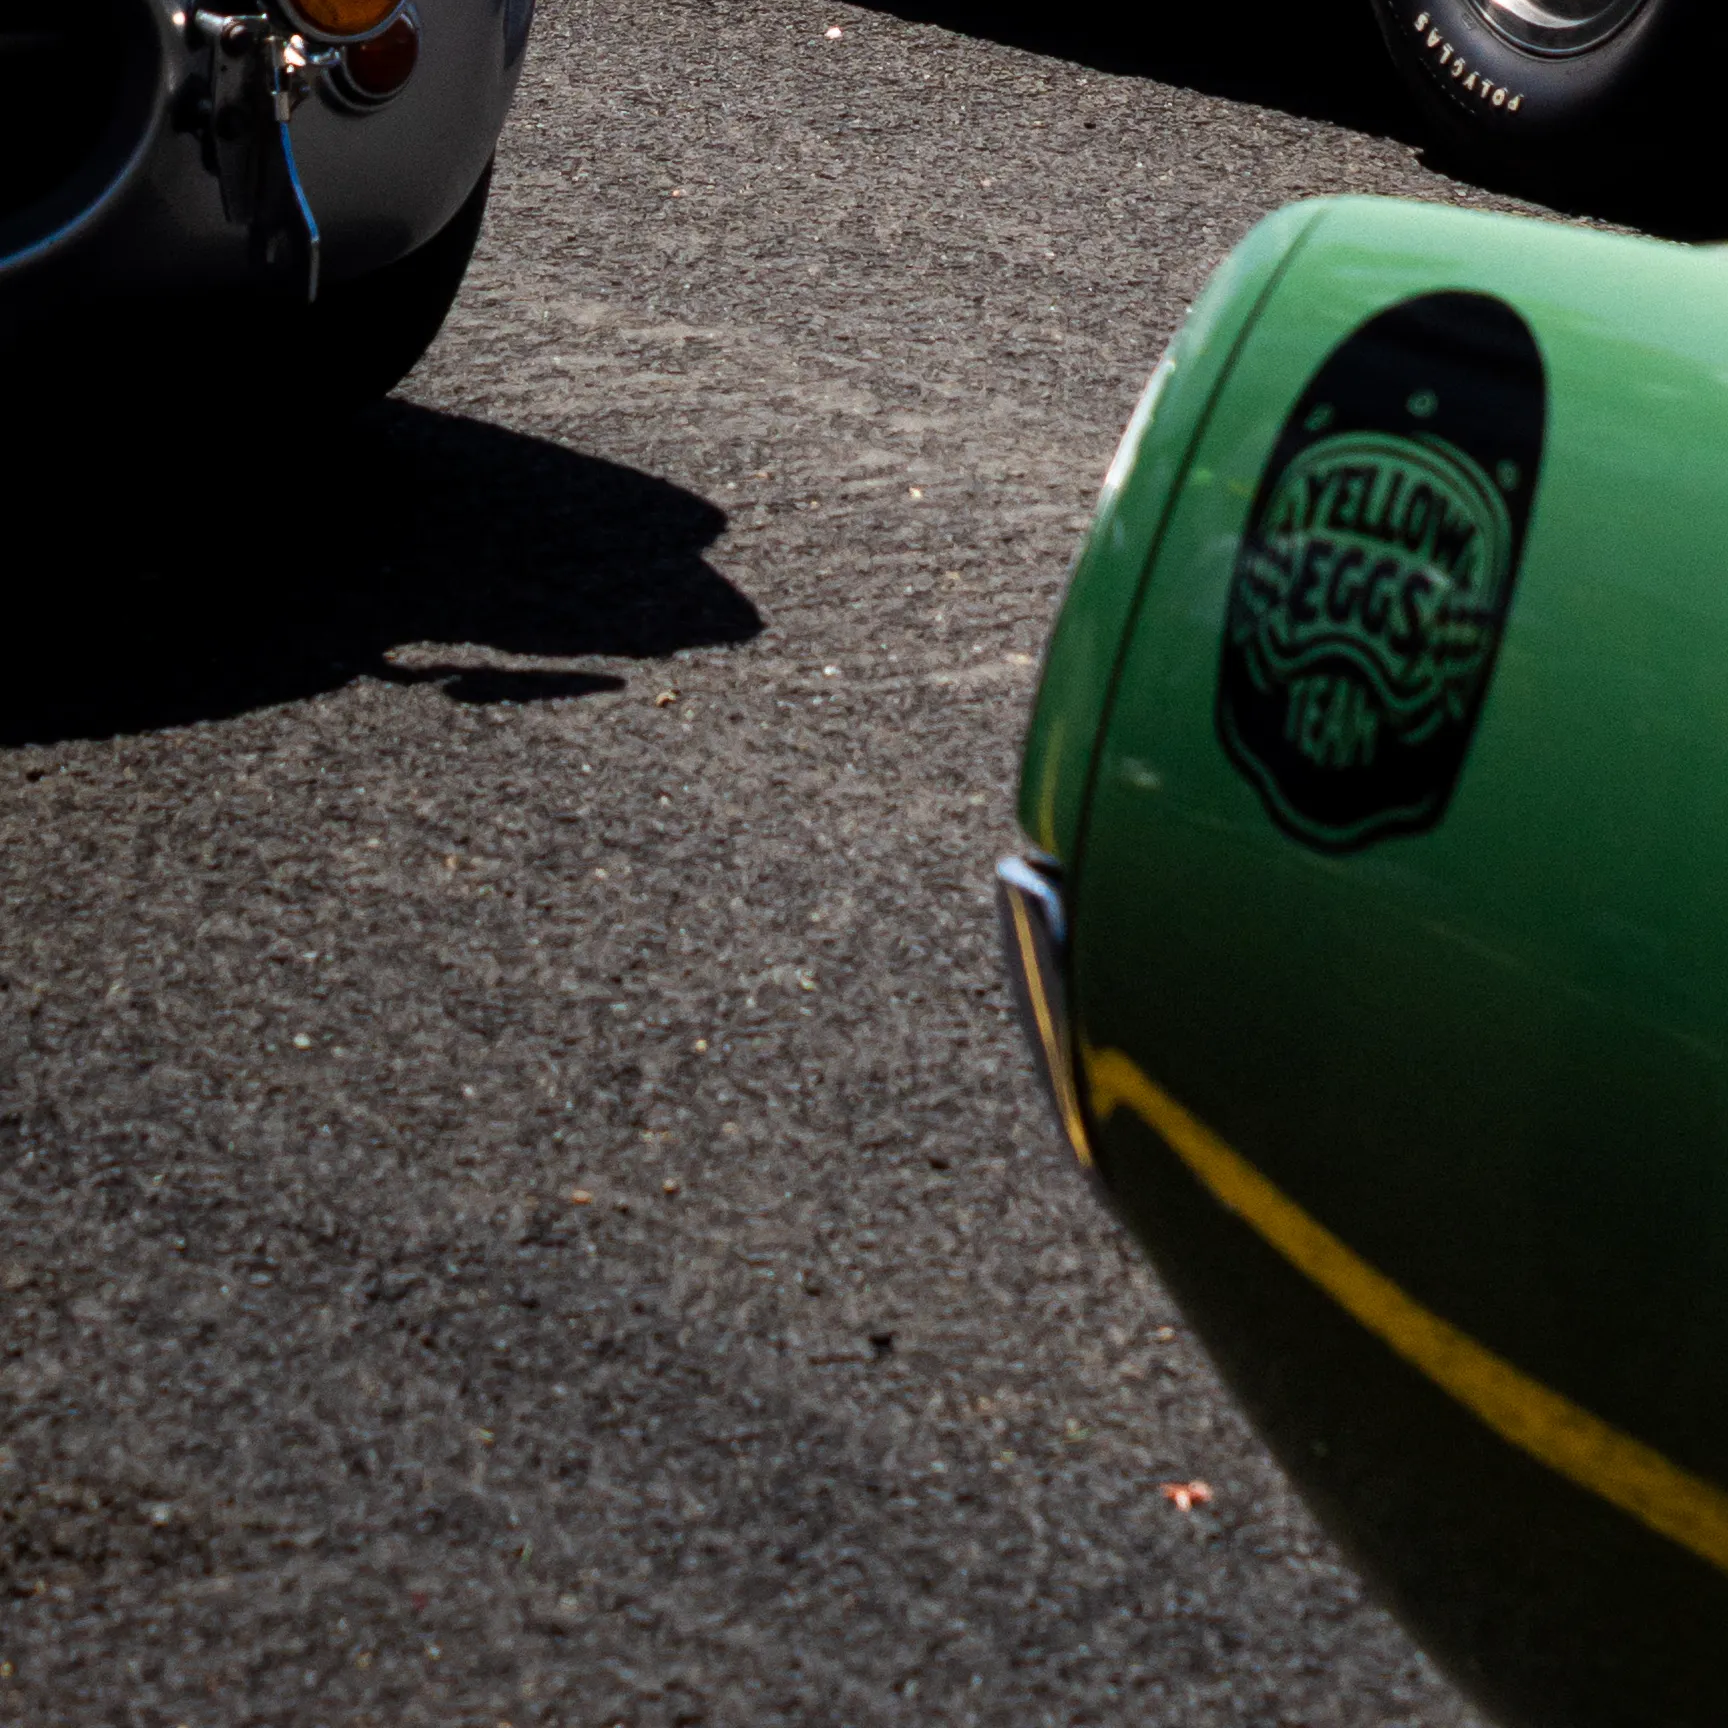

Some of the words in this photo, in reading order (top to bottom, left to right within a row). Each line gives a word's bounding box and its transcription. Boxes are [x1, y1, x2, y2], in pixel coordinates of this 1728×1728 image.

[1414, 11, 1525, 113] POLYGLAS
[1302, 464, 1480, 594] YELLOW
[1287, 539, 1432, 655] EGGS
